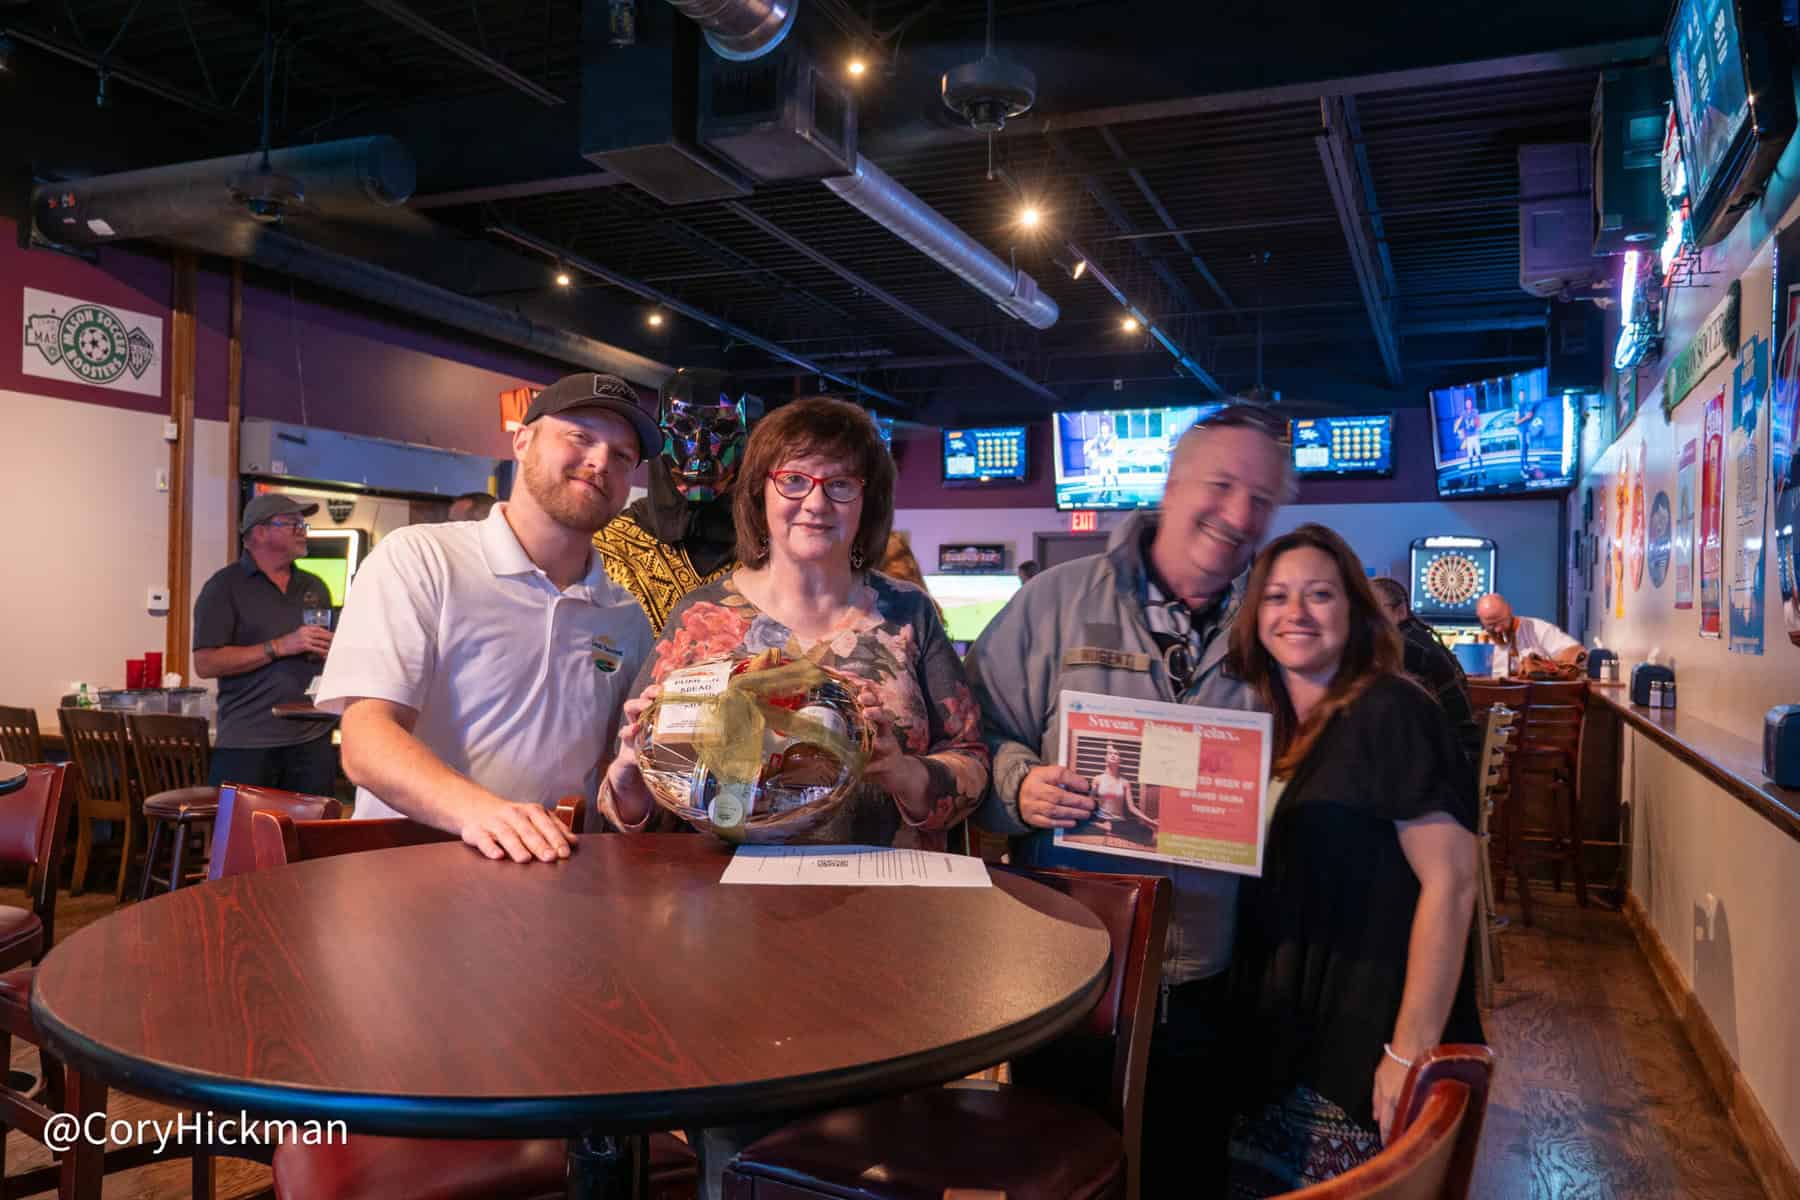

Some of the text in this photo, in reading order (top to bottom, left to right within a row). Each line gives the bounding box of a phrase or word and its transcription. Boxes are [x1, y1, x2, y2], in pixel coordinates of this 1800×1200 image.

[34, 331, 57, 344] MAS
[62, 309, 94, 346] MASON
[98, 312, 126, 354] SOCCER
[65, 349, 123, 379] BOOSTERS
[1072, 511, 1097, 531] EXIT
